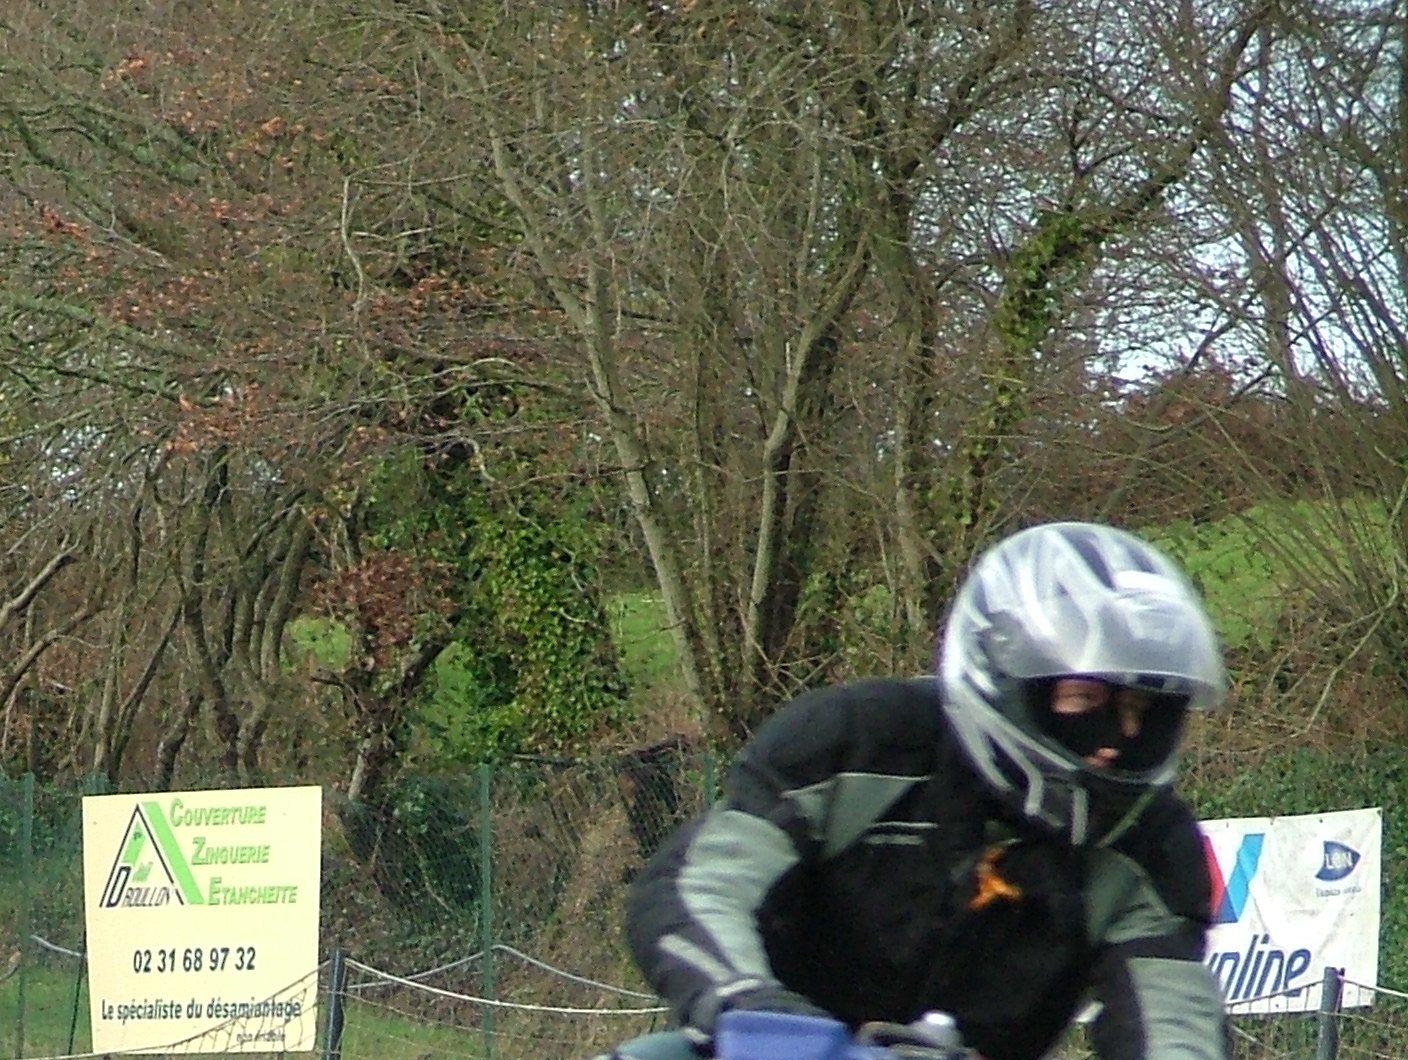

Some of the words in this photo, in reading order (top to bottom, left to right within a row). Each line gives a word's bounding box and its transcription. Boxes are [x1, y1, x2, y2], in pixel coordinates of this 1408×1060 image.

[169, 798, 267, 827] COUVERTURE
[191, 837, 271, 865] ZINGUERIE
[133, 949, 152, 973] 02
[158, 948, 177, 973] 31
[183, 947, 203, 972] 68
[209, 947, 228, 972] 97
[235, 946, 256, 971] 32
[102, 999, 113, 1019] Le
[117, 998, 182, 1025] spécialiste
[186, 998, 202, 1019] du
